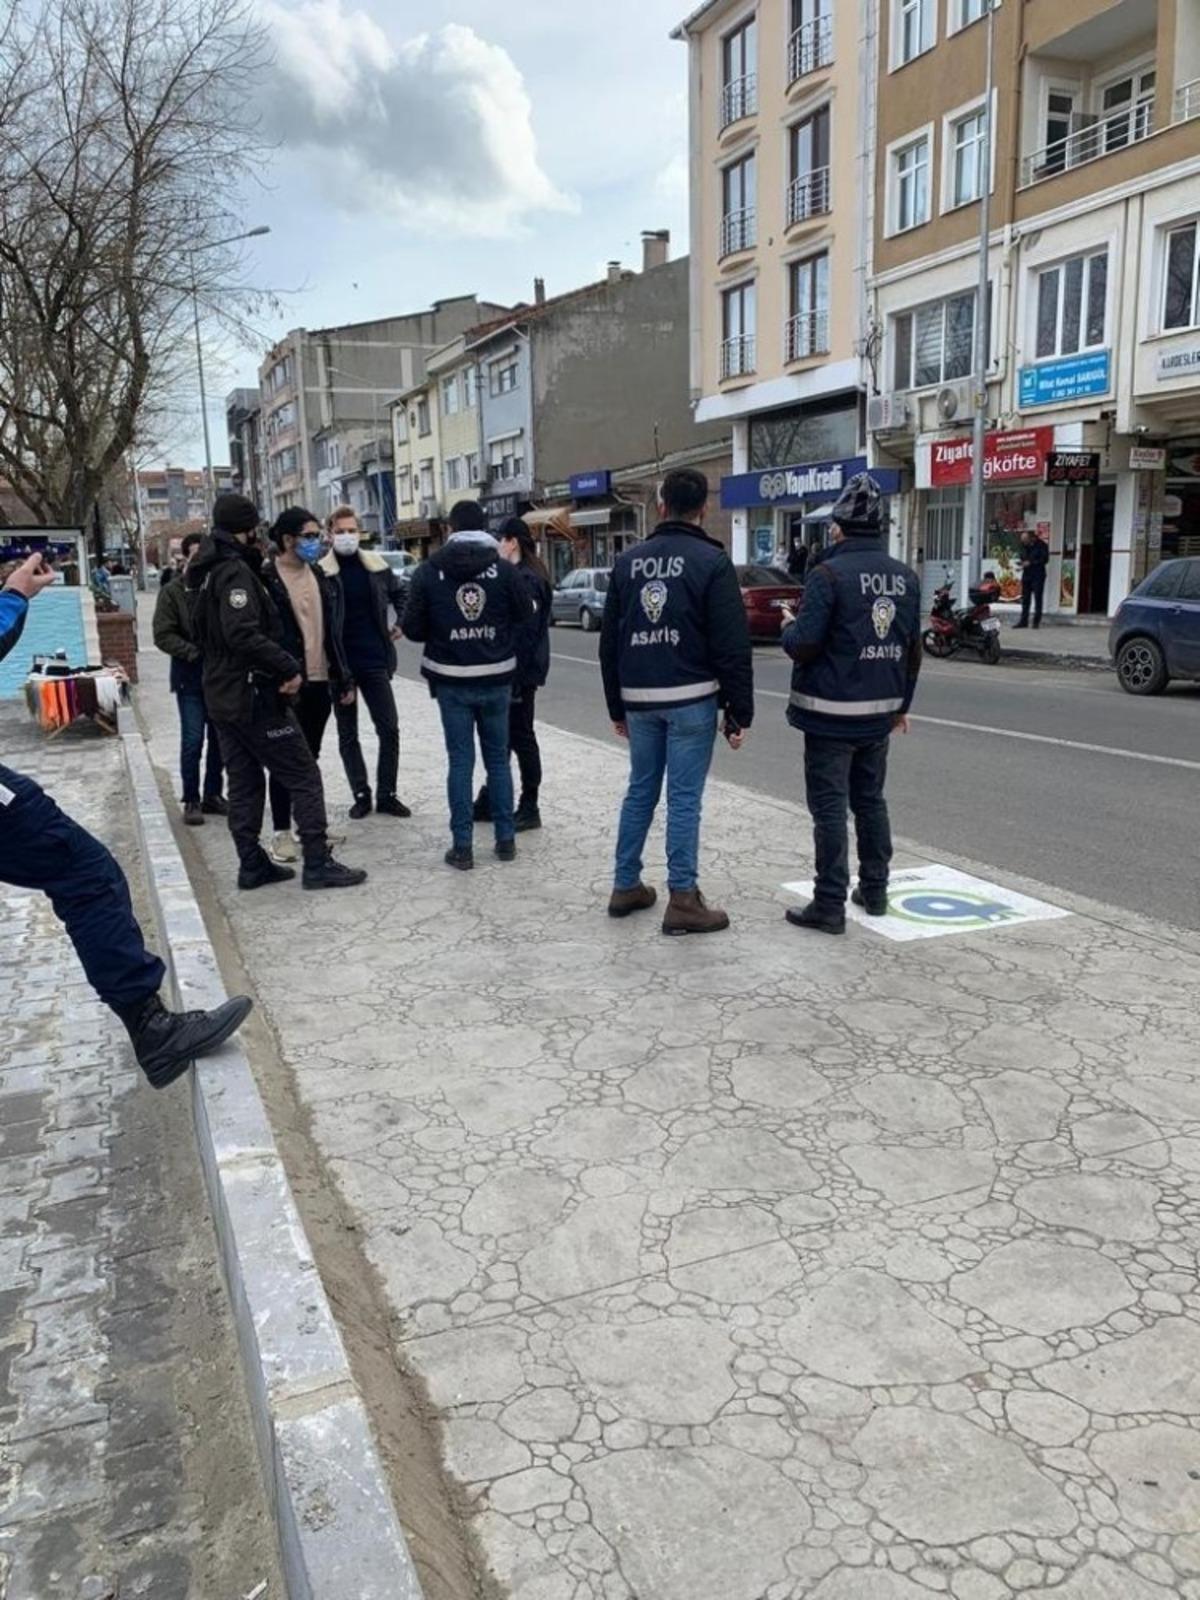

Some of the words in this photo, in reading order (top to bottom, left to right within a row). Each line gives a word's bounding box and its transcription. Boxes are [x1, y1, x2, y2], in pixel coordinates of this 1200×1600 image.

[936, 442, 975, 465] Ziyafe
[970, 453, 1037, 479] ğköfte
[450, 624, 497, 641] ASAYİŞ
[630, 625, 680, 646] ASAYİŞ
